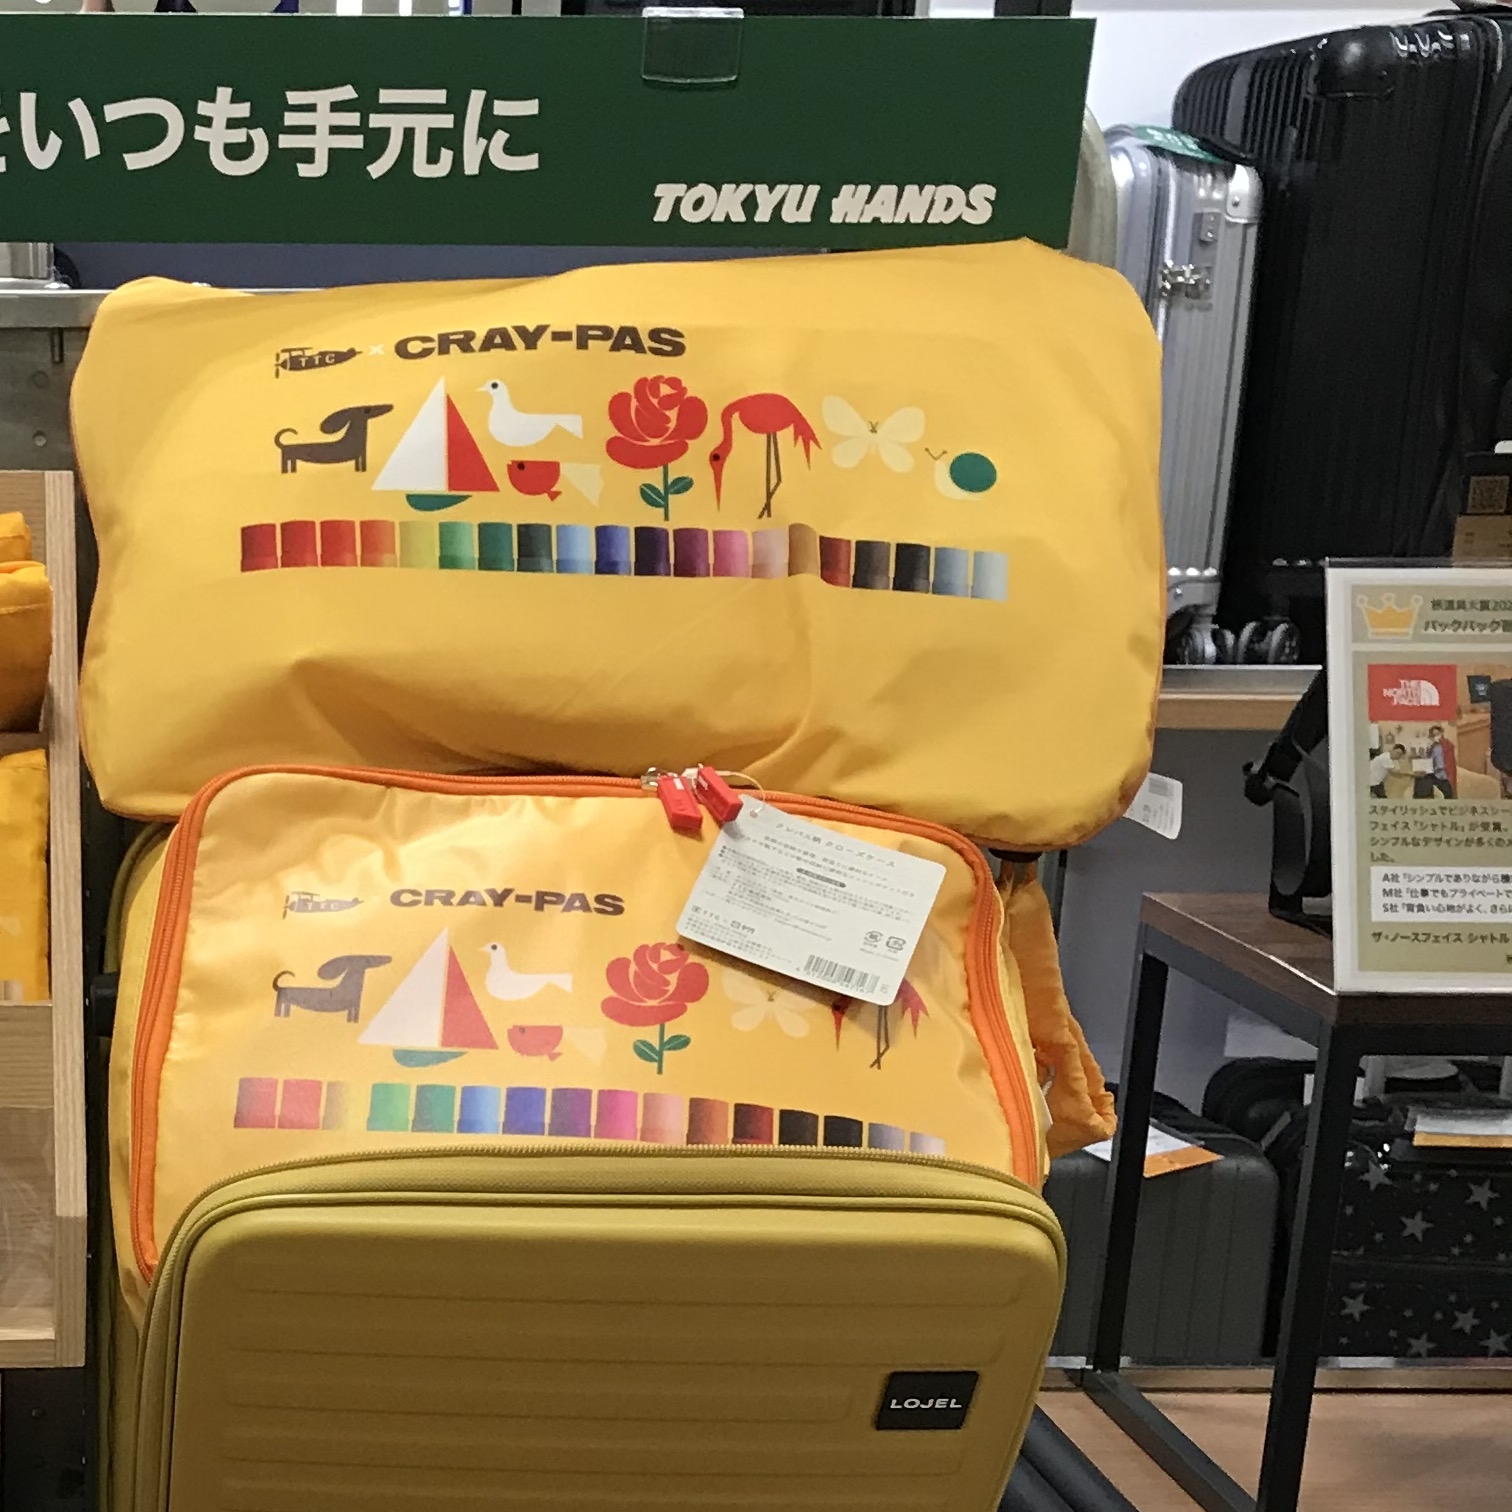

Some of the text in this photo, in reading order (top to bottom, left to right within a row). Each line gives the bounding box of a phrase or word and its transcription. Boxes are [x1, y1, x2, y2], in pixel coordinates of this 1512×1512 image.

[653, 183, 997, 225] TOKYU HANDS
[394, 323, 686, 360] CRAY-PAS
[390, 887, 625, 916] CRAY-PAS
[890, 1398, 963, 1409] LOJEL
